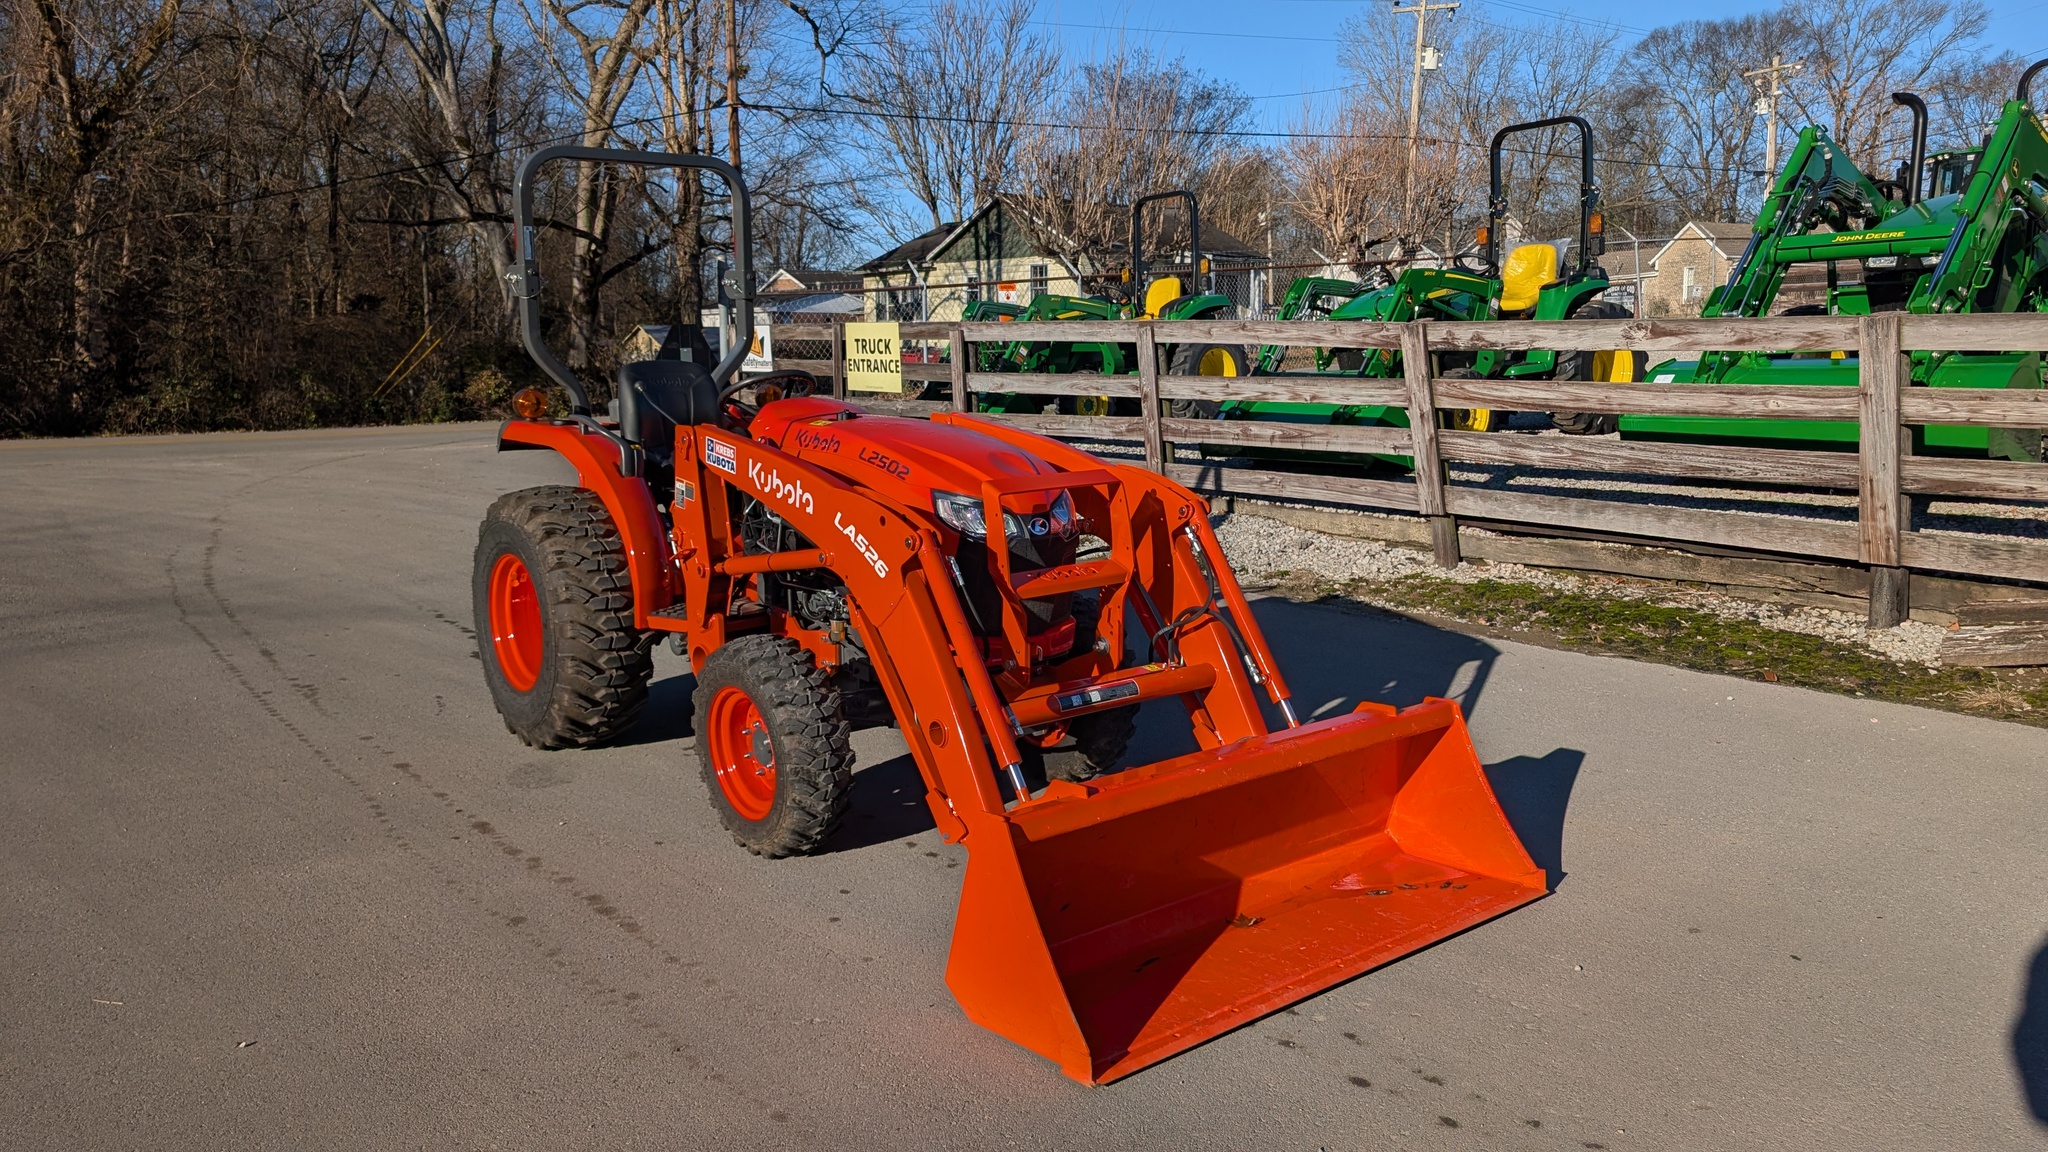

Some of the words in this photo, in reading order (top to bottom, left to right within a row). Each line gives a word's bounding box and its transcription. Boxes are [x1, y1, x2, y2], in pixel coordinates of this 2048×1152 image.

[1832, 234, 1863, 242] JOHN
[1865, 231, 1905, 239] DEERE
[854, 338, 892, 355] TRUCK
[848, 358, 900, 374] ENTRANCE
[715, 443, 735, 459] KREBS
[795, 428, 841, 453] Kubota
[707, 451, 736, 473] KUBOTA
[858, 447, 911, 481] L2502
[748, 458, 814, 515] Kubota
[834, 511, 889, 579] LA526
